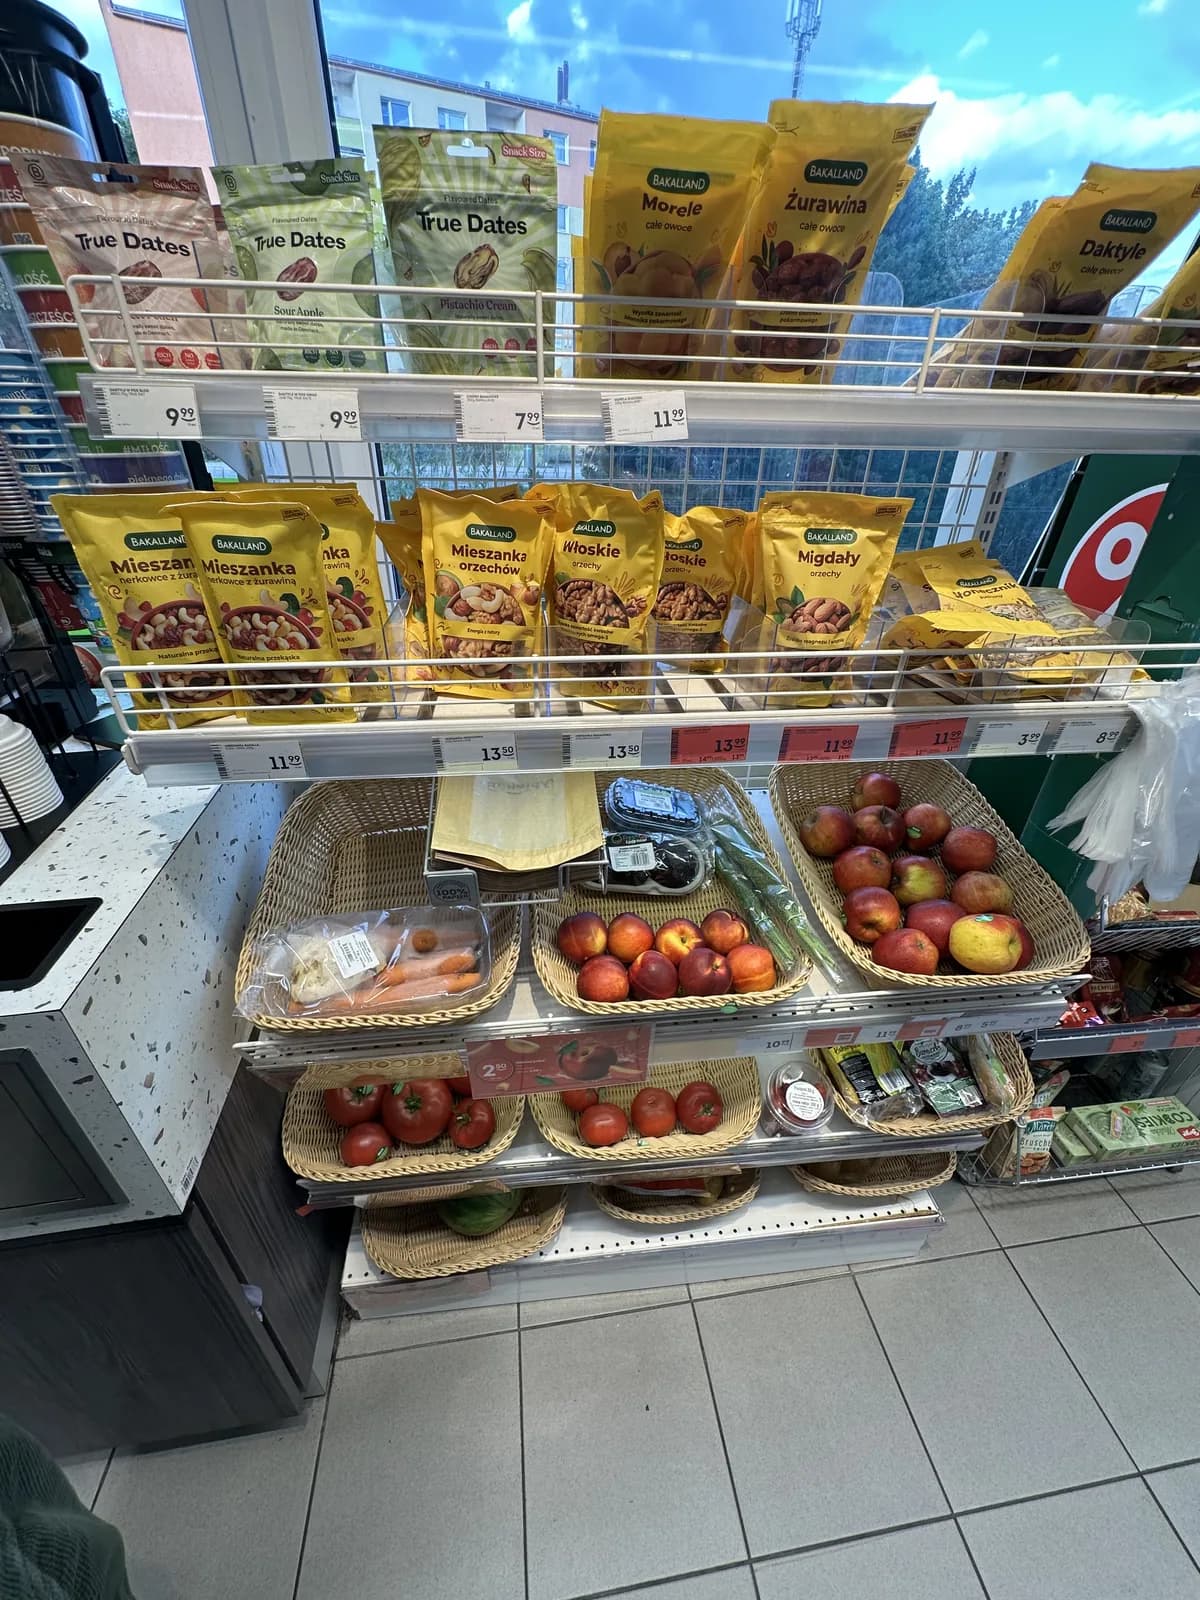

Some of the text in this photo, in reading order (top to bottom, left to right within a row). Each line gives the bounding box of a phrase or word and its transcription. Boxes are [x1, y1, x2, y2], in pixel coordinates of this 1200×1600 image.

[503, 146, 546, 158] Snack Size
[320, 170, 359, 184] Snack Size
[810, 165, 864, 180] BAKALLAND
[653, 174, 706, 190] BAKALLAND
[642, 192, 703, 217] Morele
[784, 187, 867, 214] Żurawina
[416, 211, 527, 235] True Dates
[646, 220, 693, 232] całe owoce
[800, 221, 818, 232] całe
[1105, 214, 1152, 229] BAKALLAND
[75, 232, 191, 257] True Dates
[254, 232, 346, 252] True Dates
[1080, 239, 1147, 263] Daktyle
[274, 305, 296, 316] Sour
[441, 298, 517, 311] Pistachio Cream
[470, 527, 513, 539] BAKALLAND
[807, 533, 854, 541] BAKALLAND
[217, 540, 267, 551] BAKALLAND
[563, 540, 621, 558] Włoskie
[452, 544, 527, 562] Mieszanka
[798, 550, 861, 567] Migdały
[110, 557, 195, 575] Mieszan
[202, 559, 297, 576] Mieszanka
[459, 562, 520, 576] orzechów
[572, 560, 602, 572] orzechy
[120, 574, 168, 585] nerkowce
[207, 576, 245, 586] nerkowce
[254, 576, 297, 586] żurawiną
[810, 570, 842, 579] orzechy
[158, 651, 194, 660] Naturalna
[266, 654, 301, 662] przekąska
[622, 686, 636, 694] 100
